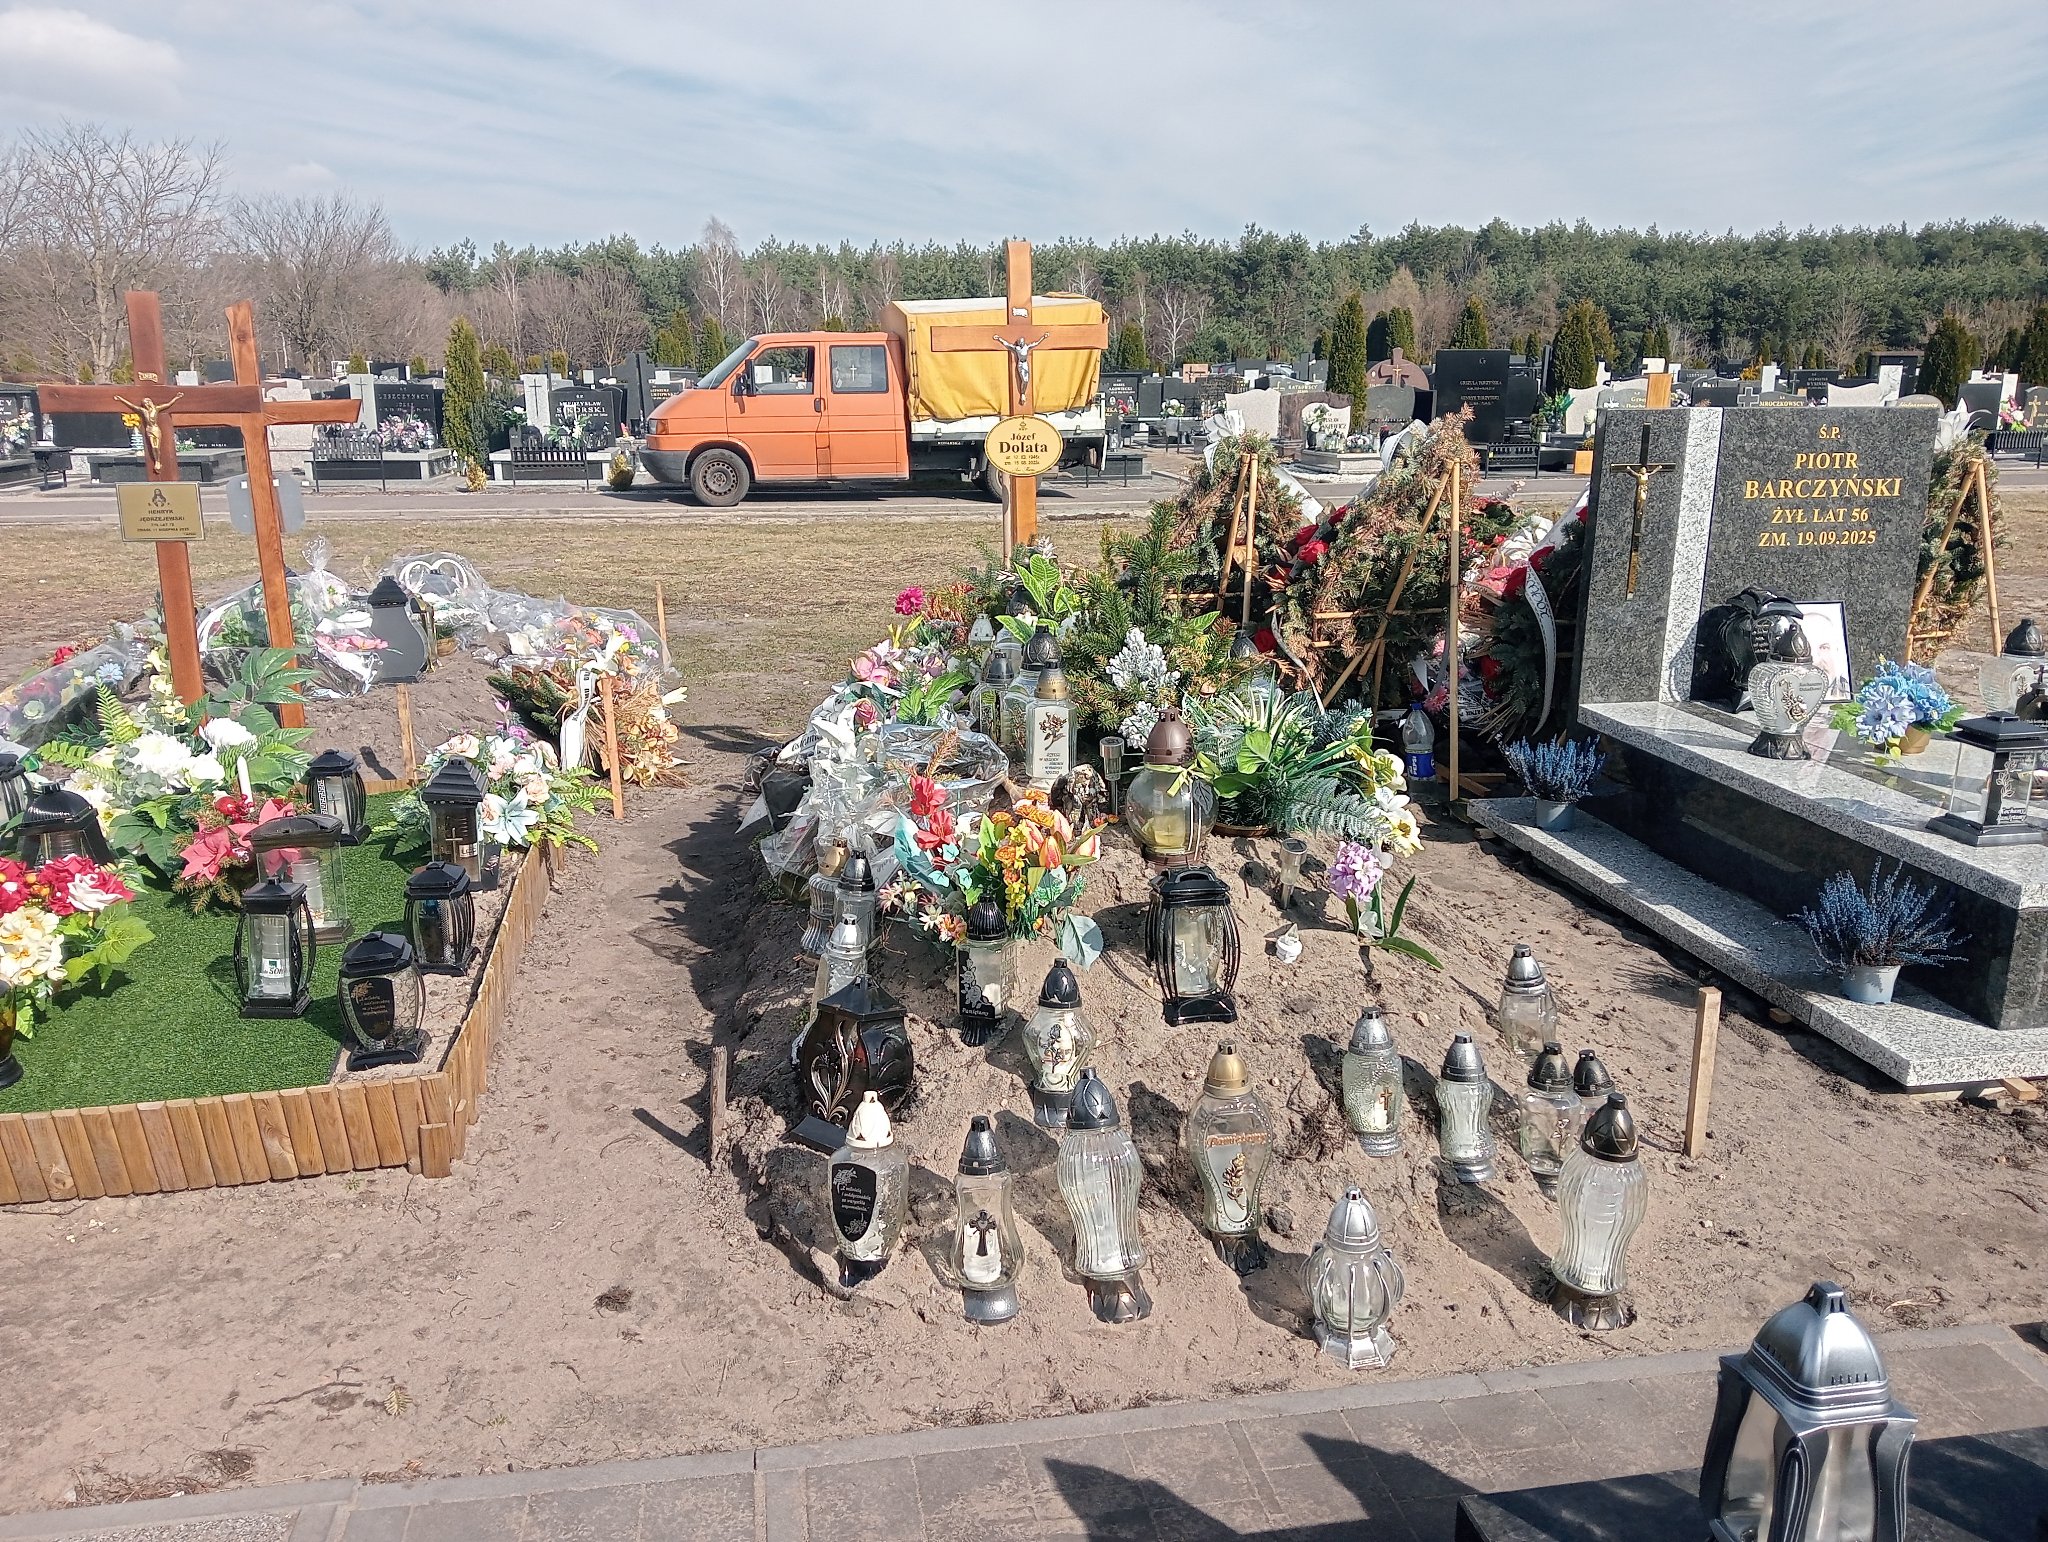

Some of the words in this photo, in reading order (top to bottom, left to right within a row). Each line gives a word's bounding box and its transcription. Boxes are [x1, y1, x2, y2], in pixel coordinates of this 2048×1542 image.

[1010, 433, 1037, 441] Józef
[1818, 424, 1841, 439] Ś.P.
[998, 441, 1049, 454] Dolata
[1795, 452, 1859, 470] PIOTR
[1744, 474, 1902, 499] BARCZYŃSKI
[1771, 507, 1807, 524] ŻYŁ
[1812, 508, 1847, 523] LAT
[1851, 508, 1869, 522] 56
[1758, 532, 1791, 547] ZM.
[1796, 530, 1877, 546] 19.09.2025
